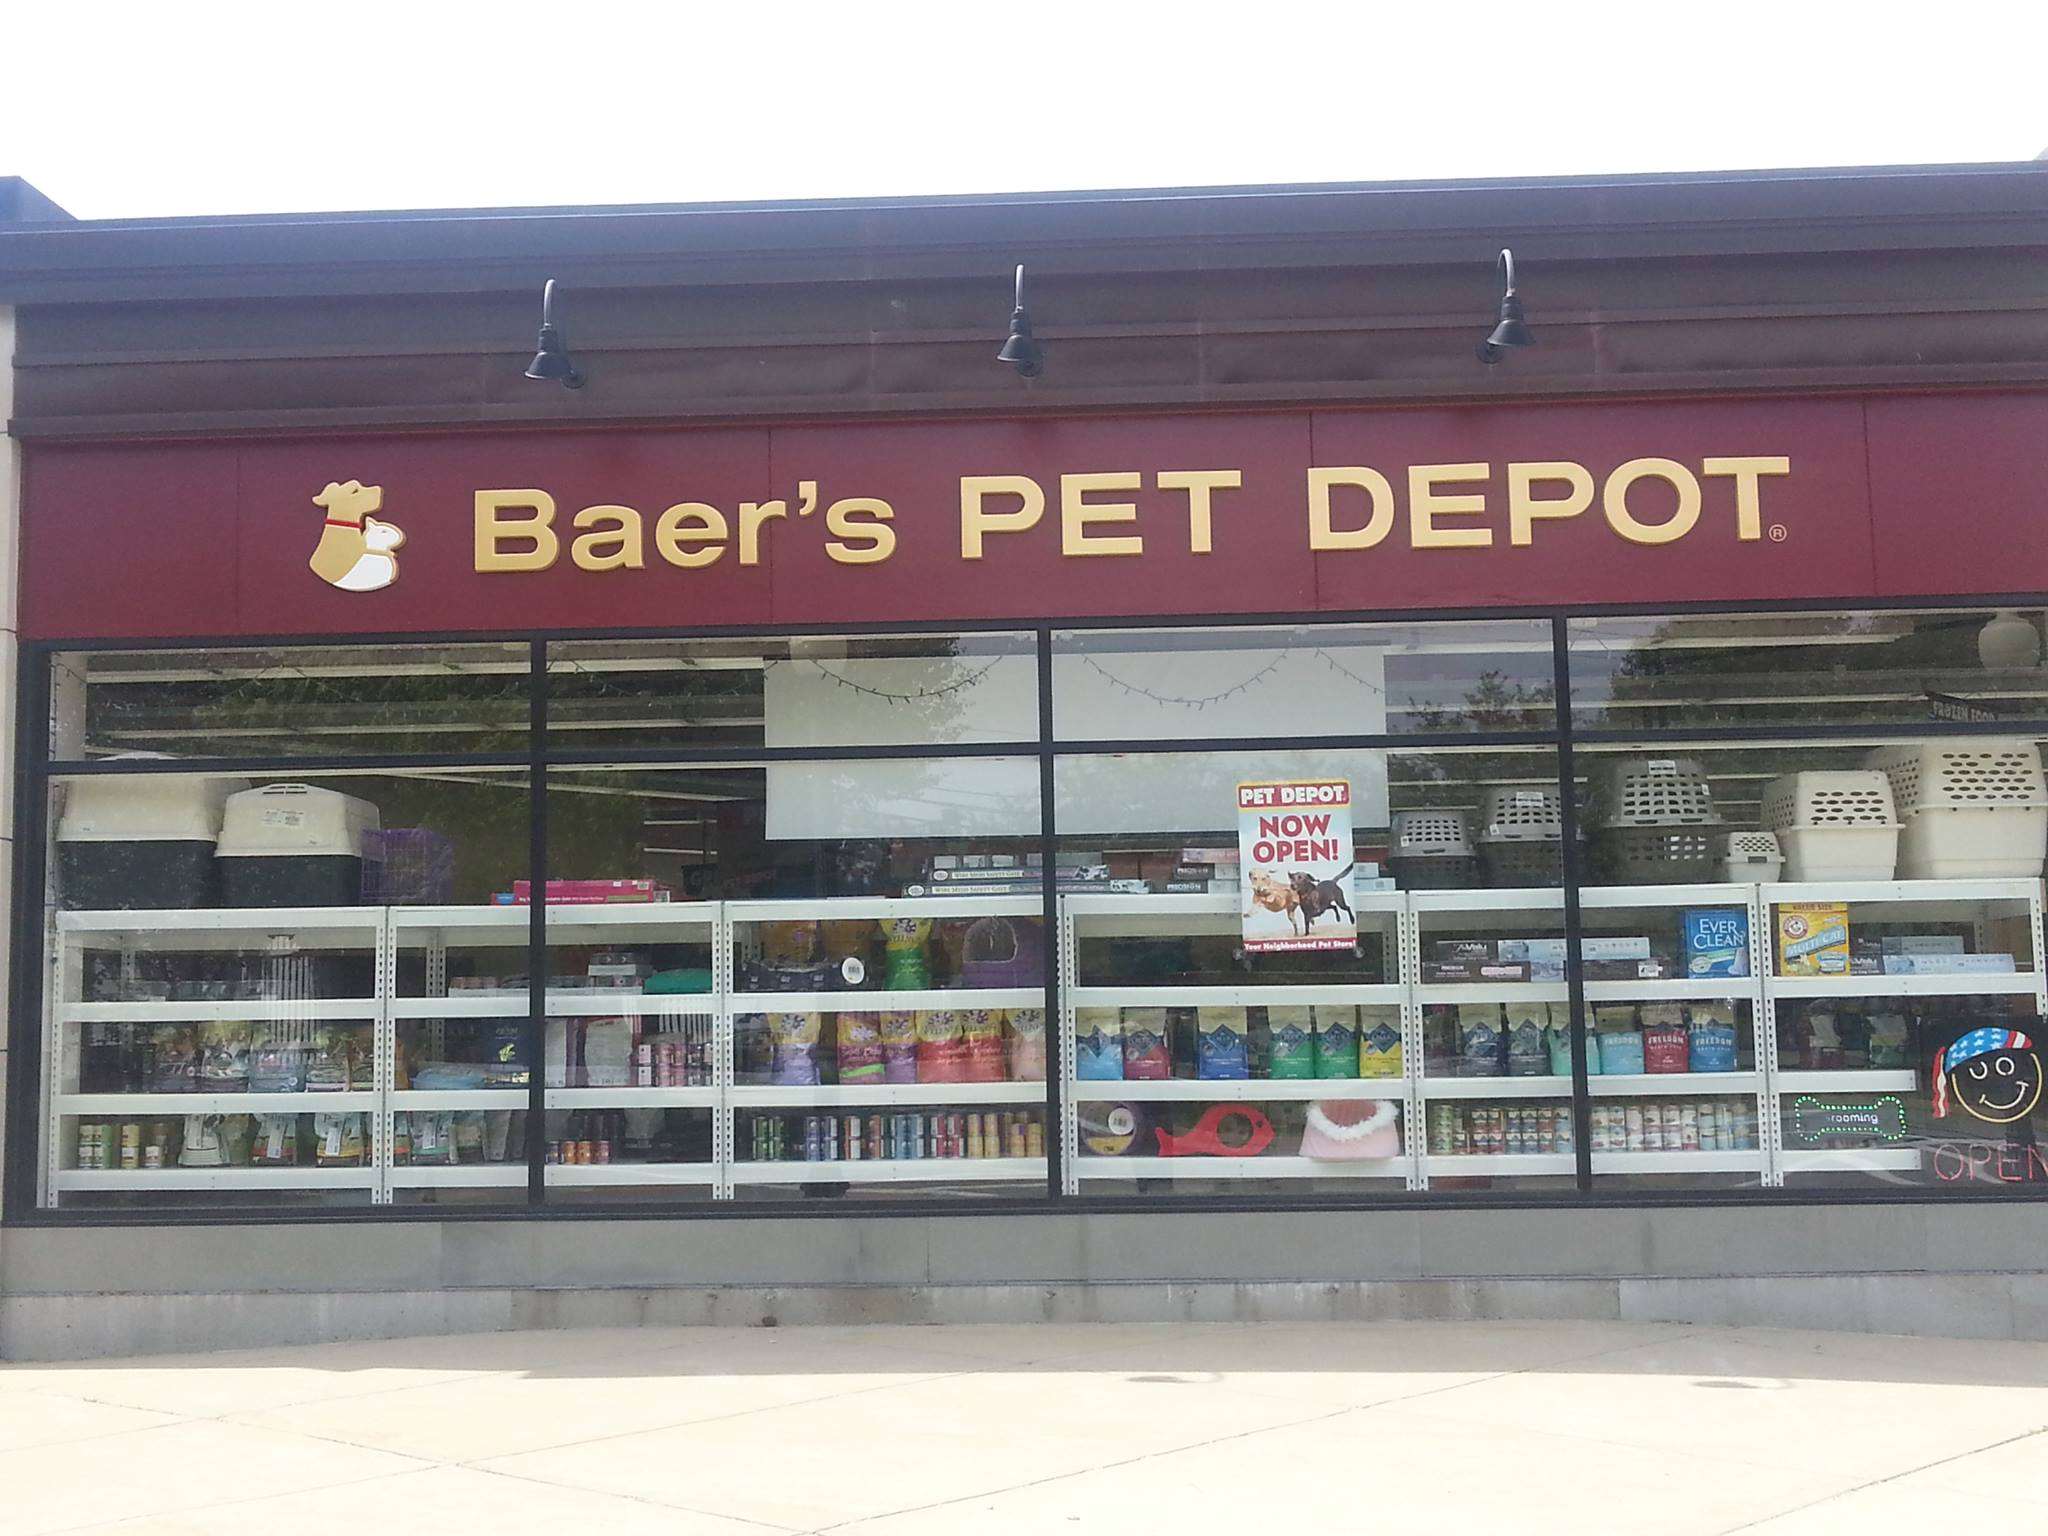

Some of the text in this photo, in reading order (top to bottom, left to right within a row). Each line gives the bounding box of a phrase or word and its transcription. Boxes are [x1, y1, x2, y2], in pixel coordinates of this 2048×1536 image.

[474, 456, 1791, 573] Baer's PET DEPOT
[1240, 785, 1346, 805] PET DEPOT
[1259, 814, 1332, 838] NOW
[1252, 839, 1339, 864] OPEN!
[1699, 918, 1738, 935] EVER
[1693, 933, 1744, 950] CLEAN
[1935, 1143, 2047, 1181] OPEN
